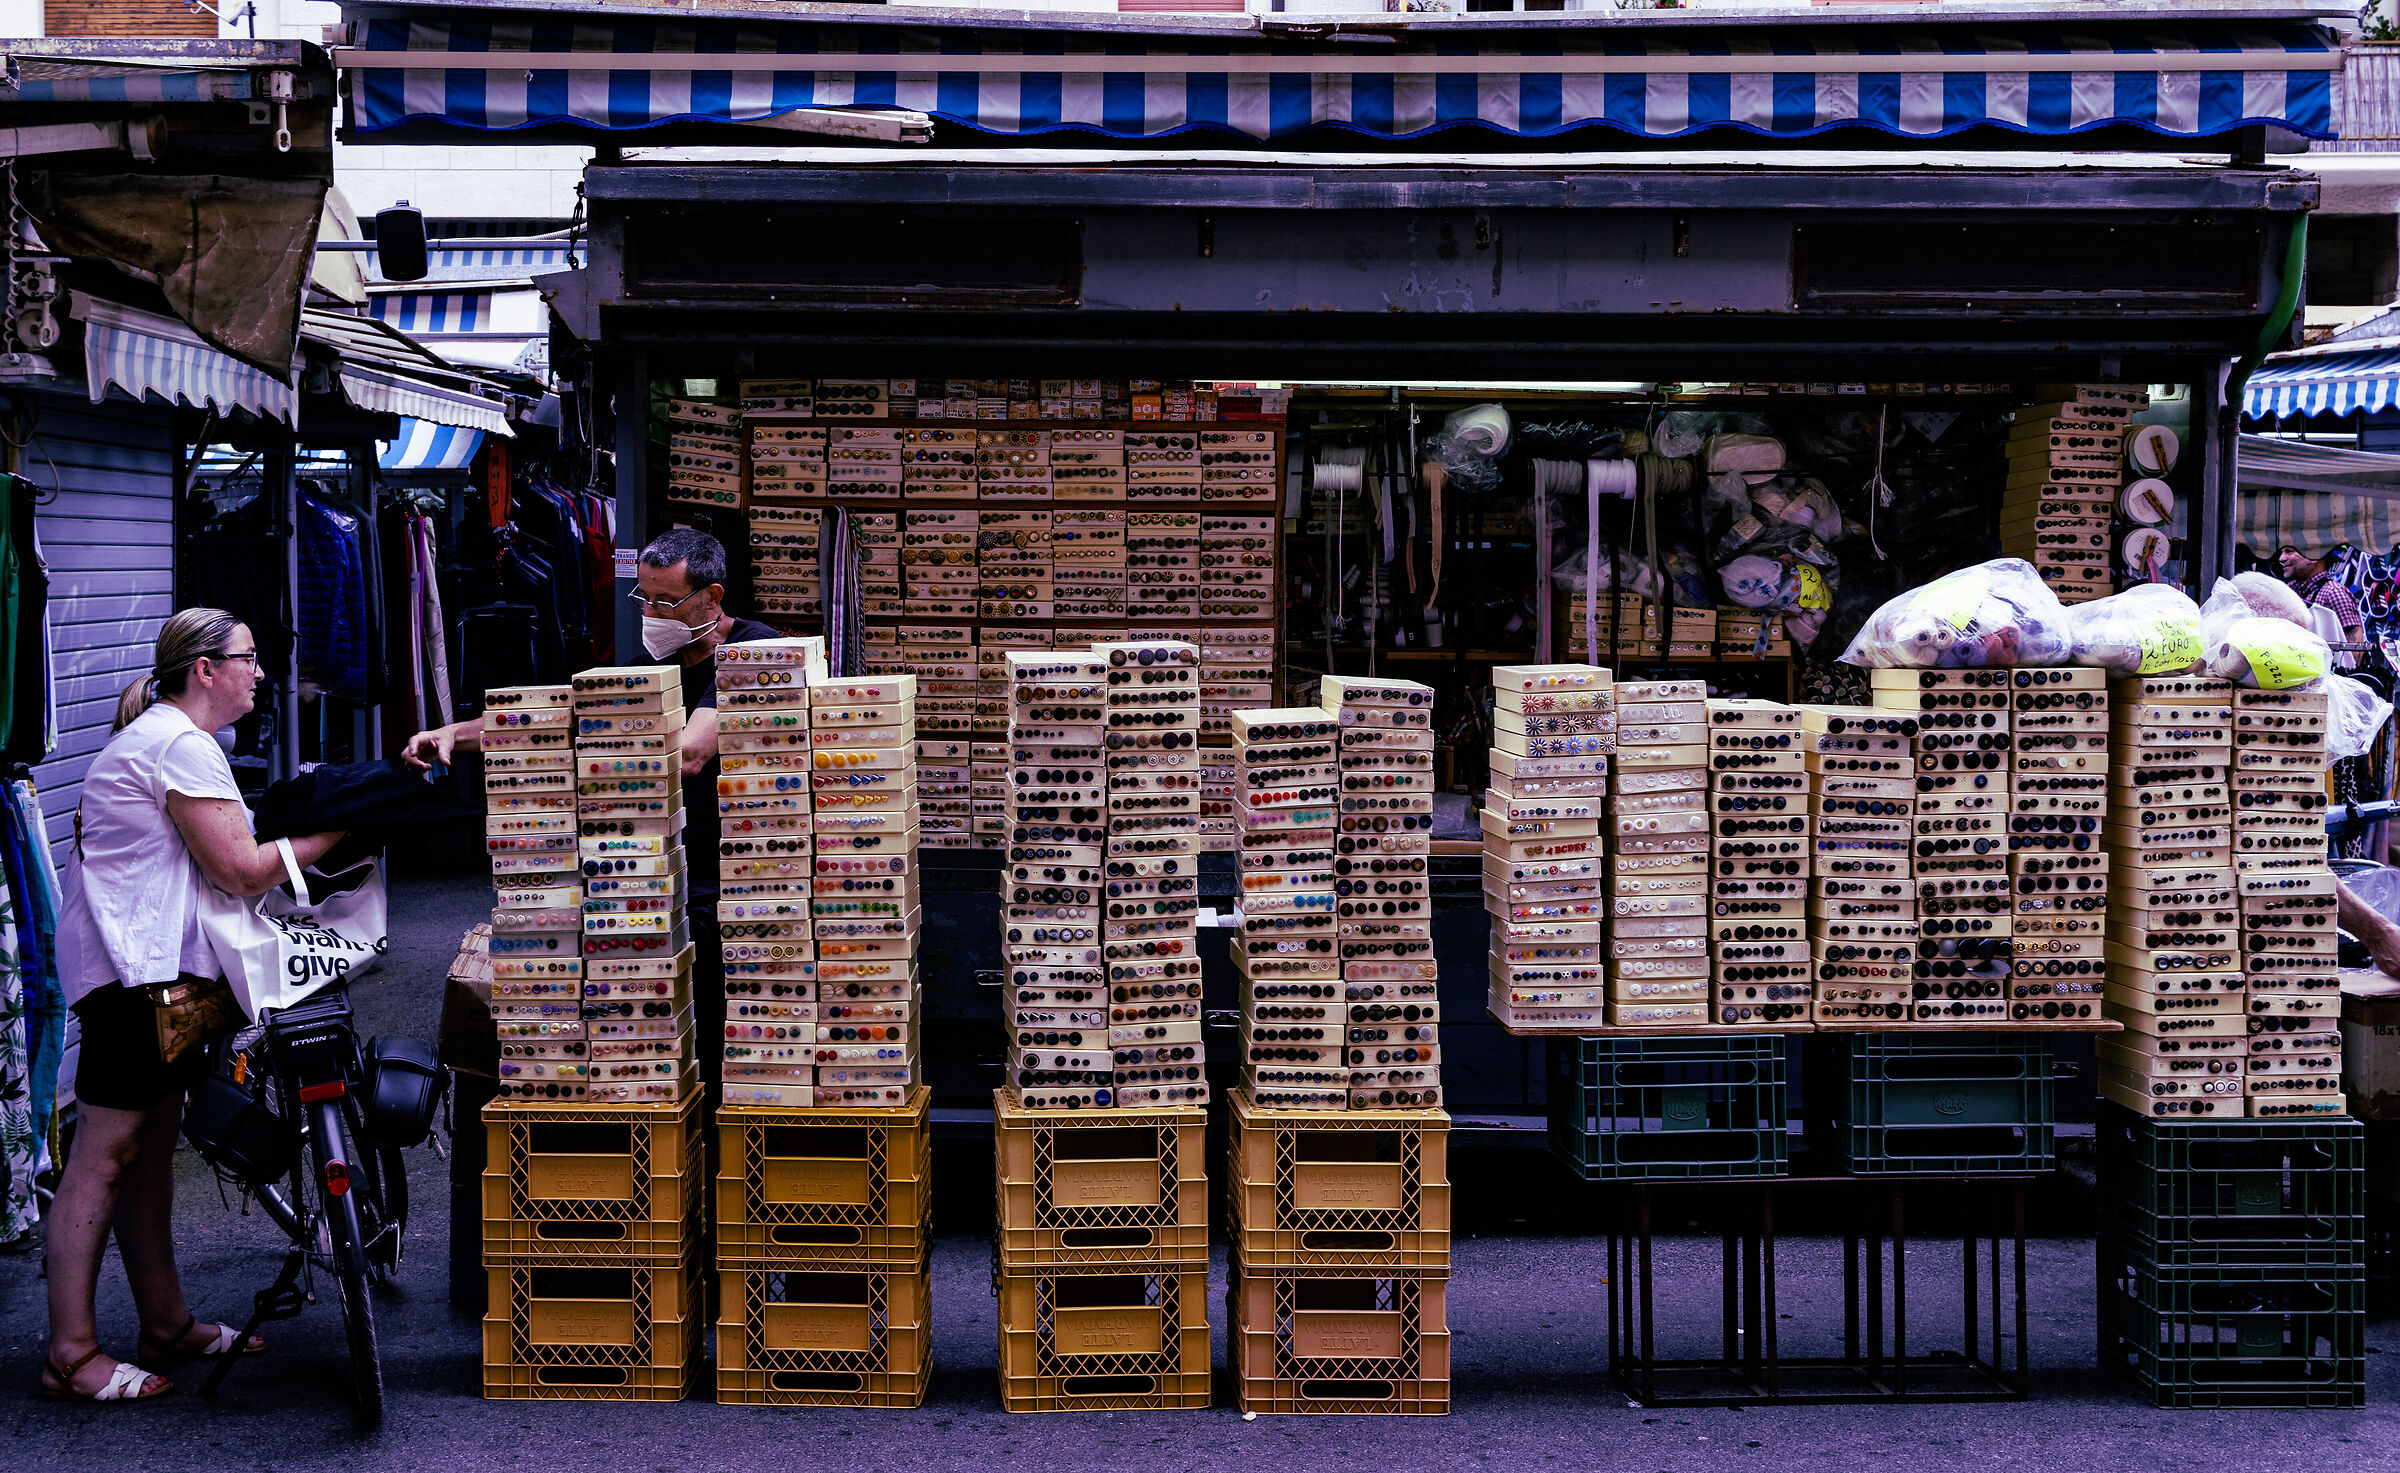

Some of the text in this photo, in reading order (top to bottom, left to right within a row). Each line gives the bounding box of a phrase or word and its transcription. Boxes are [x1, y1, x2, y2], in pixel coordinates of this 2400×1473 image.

[1803, 568, 1818, 583] 2
[2145, 638, 2190, 660] 2 EURO
[287, 947, 350, 986] give
